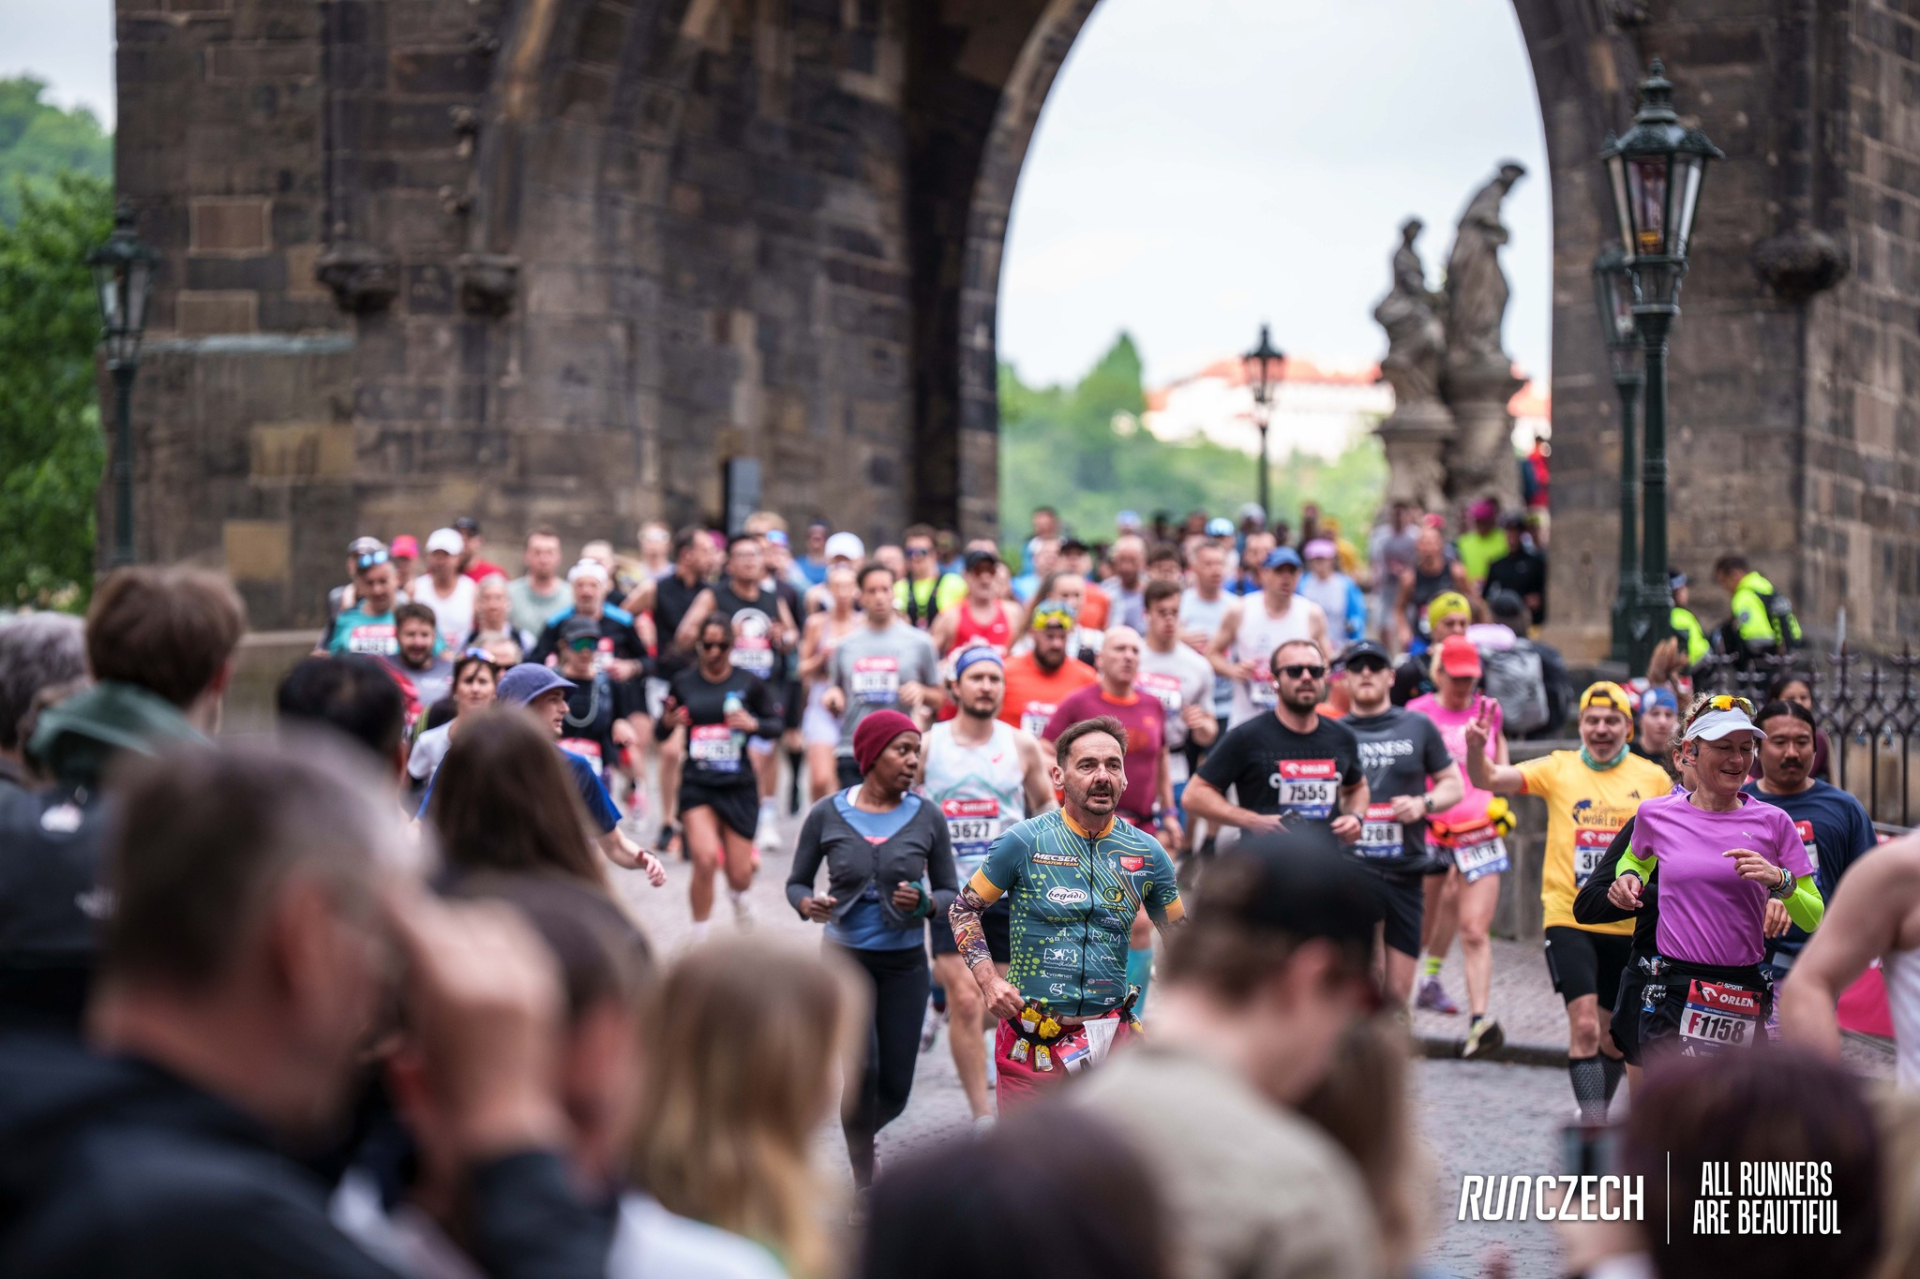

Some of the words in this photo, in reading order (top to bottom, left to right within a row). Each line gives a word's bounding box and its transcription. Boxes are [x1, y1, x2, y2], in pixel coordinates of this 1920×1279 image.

[1300, 763, 1331, 774] ORLEN
[1289, 784, 1328, 801] 7555
[1033, 852, 1079, 863] MECSEK
[1719, 993, 1754, 1008] ORLEN
[1687, 1011, 1746, 1044] F1158
